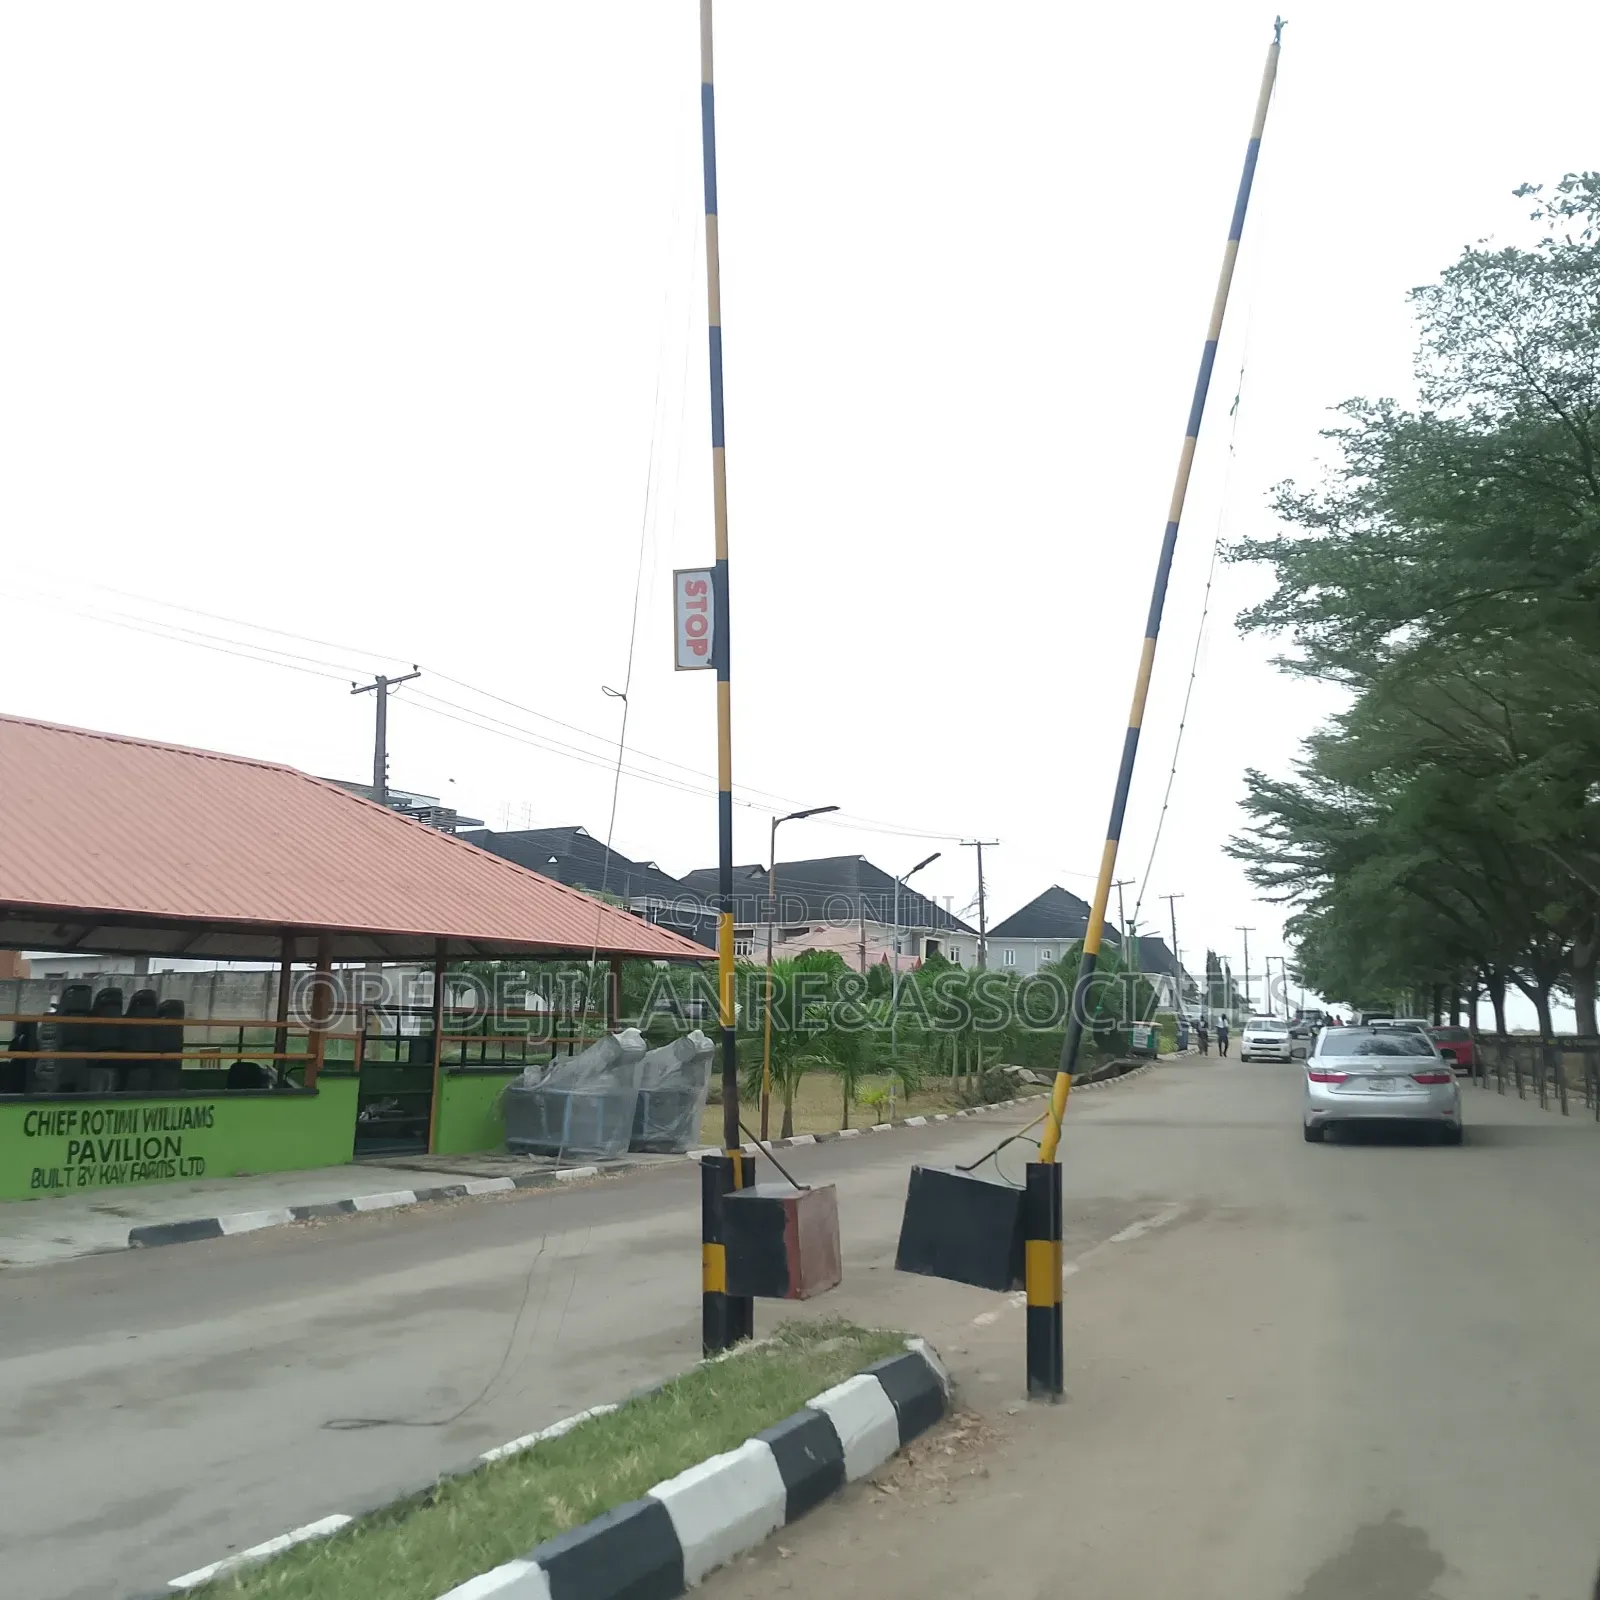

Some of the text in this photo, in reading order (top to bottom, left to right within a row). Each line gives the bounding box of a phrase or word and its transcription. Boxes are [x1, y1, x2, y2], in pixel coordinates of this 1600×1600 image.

[685, 580, 708, 656] STOP
[23, 1105, 214, 1137] CHIEF ROTIMI WILLIAMS
[67, 1136, 182, 1164] PAVILION
[31, 1156, 206, 1188] BUILT BY KAY FARMS LTD
